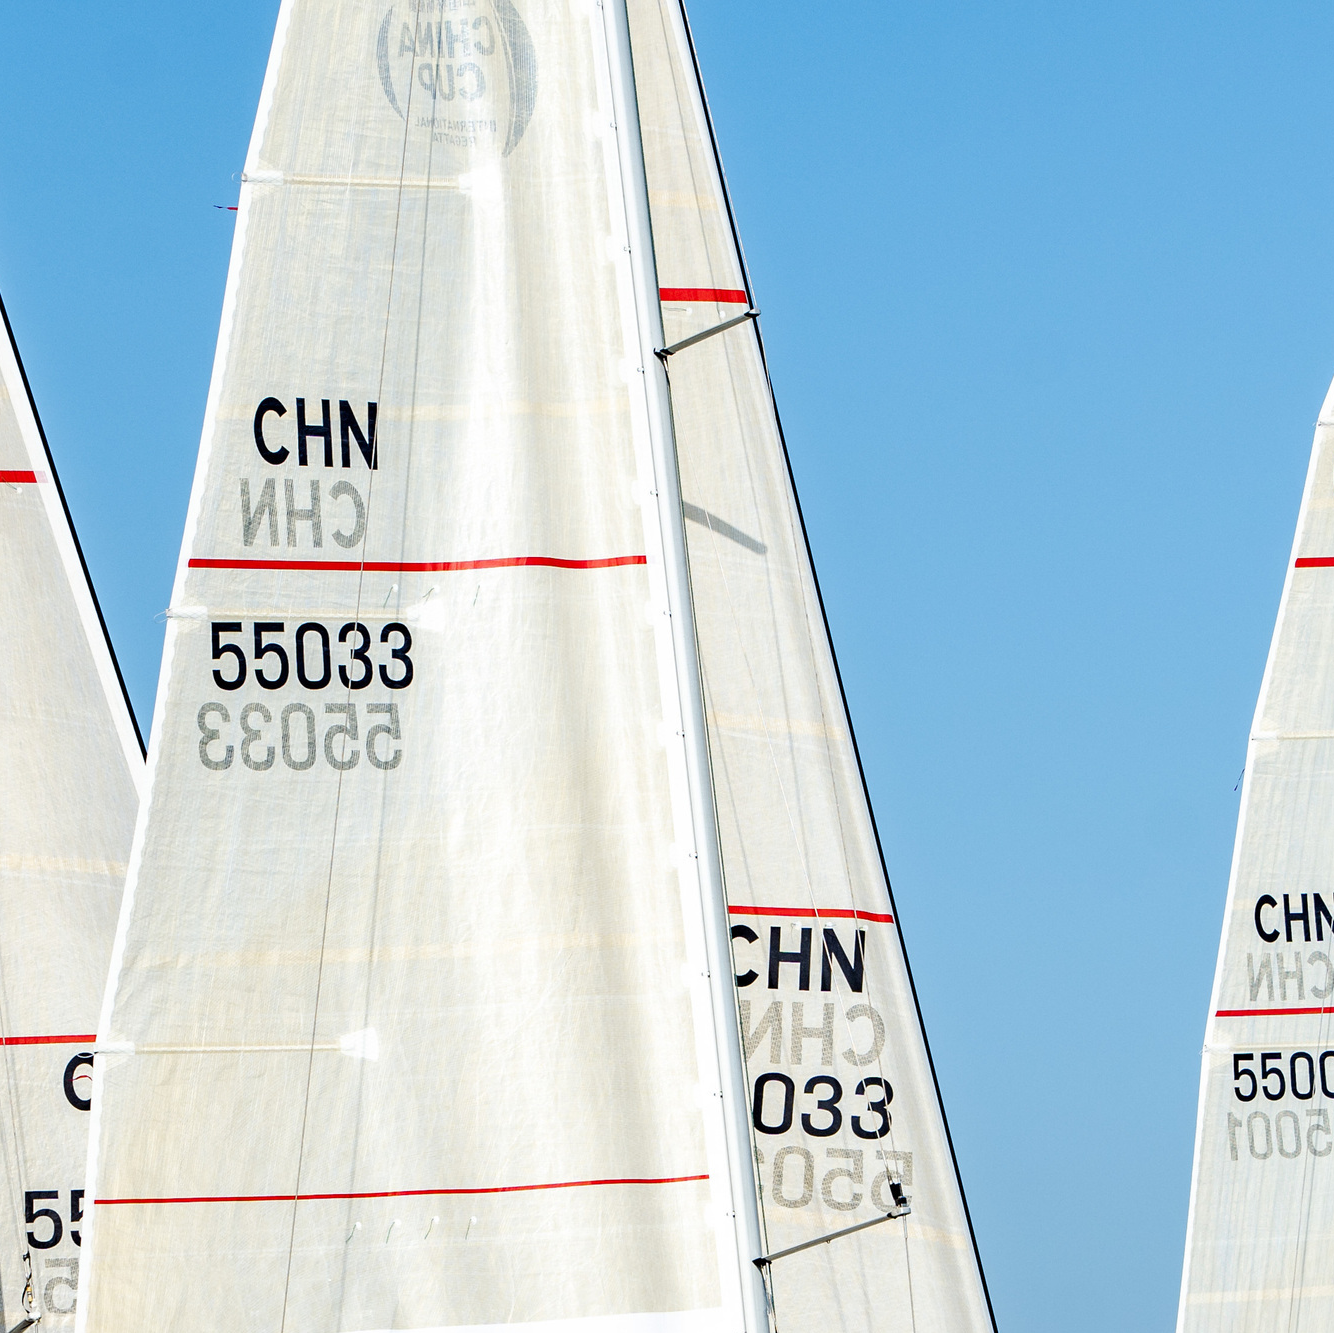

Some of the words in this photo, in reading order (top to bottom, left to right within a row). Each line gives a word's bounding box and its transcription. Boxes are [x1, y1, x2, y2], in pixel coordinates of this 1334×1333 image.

[253, 396, 379, 471] CHN
[210, 622, 414, 691] 55033
[731, 924, 866, 993] CHN
